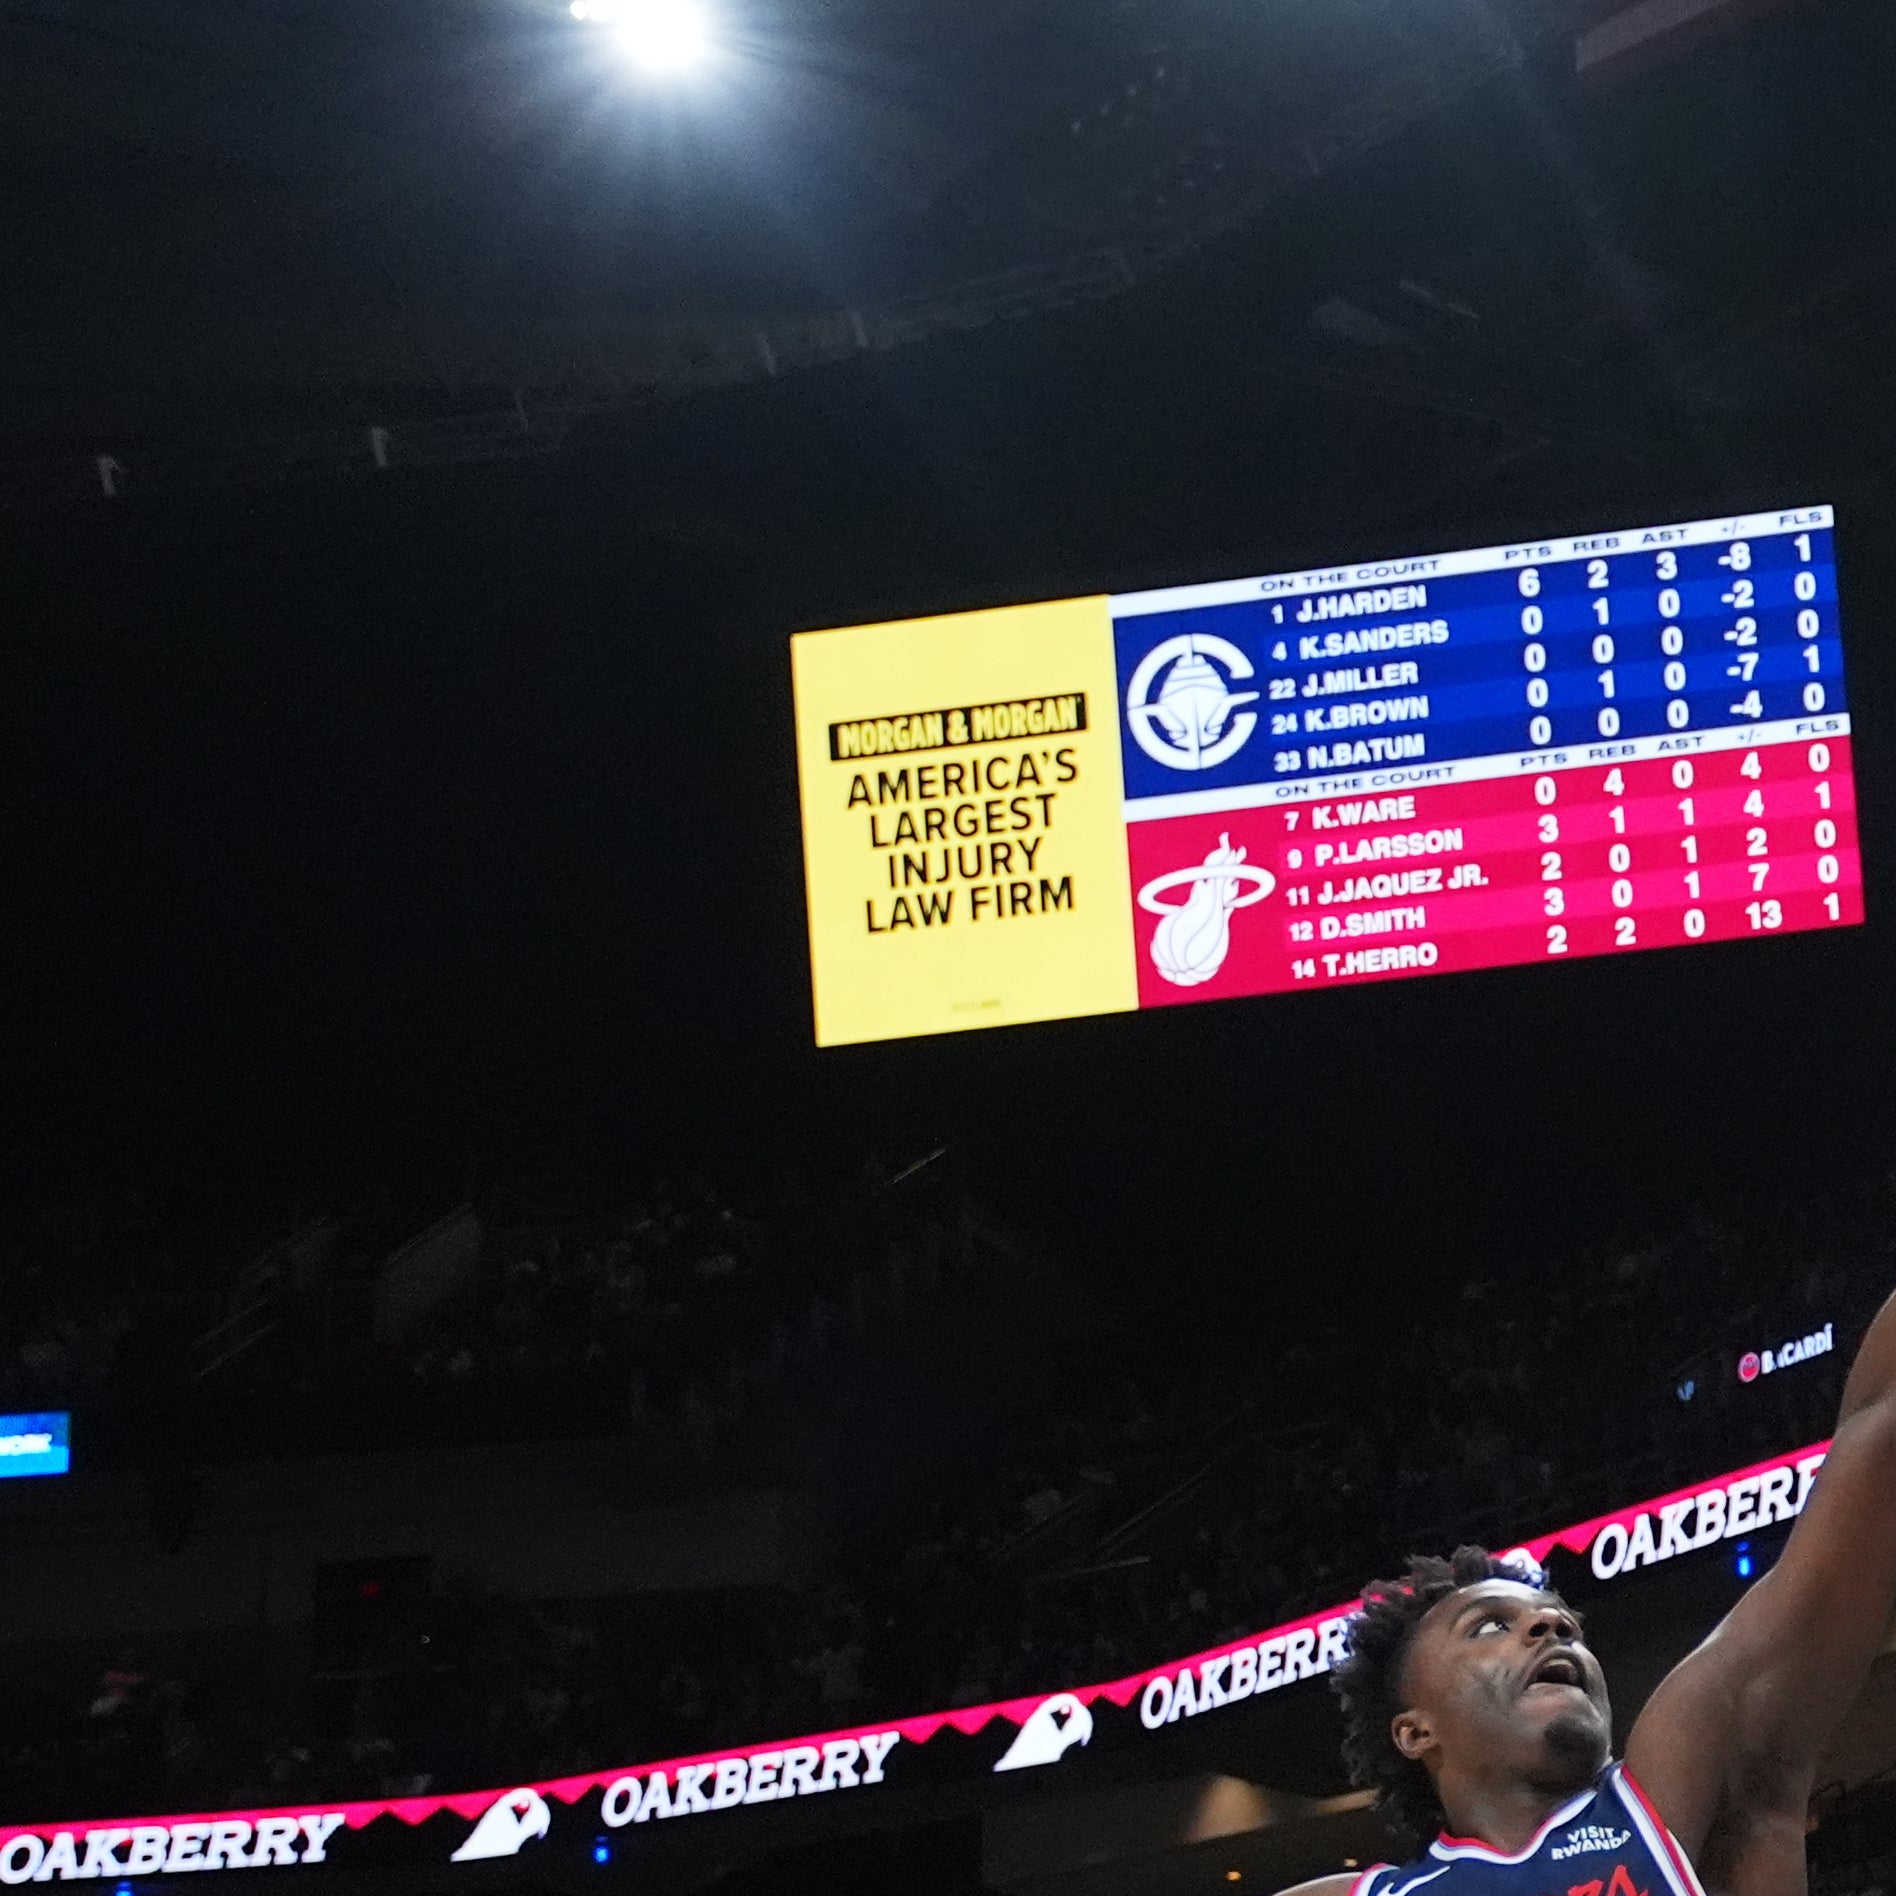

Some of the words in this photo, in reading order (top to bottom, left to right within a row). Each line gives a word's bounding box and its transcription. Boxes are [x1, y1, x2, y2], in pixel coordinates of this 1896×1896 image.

[1261, 578, 1294, 592] ON
[1303, 572, 1348, 587] THE
[1356, 559, 1441, 581] COURT
[1504, 546, 1552, 561] PTS
[1573, 538, 1620, 552] REB
[1641, 528, 1690, 545] AST
[1779, 511, 1823, 527] FLS
[1271, 603, 1284, 625] 1
[1296, 585, 1427, 623] J.HARDEN
[1518, 568, 1541, 598] 6
[1586, 559, 1610, 589] 2
[1656, 551, 1679, 580] 3
[1717, 541, 1752, 571] -8
[1793, 533, 1811, 562] 1
[1269, 678, 1297, 700] 22
[1302, 661, 1419, 698] J.MILLER
[1524, 643, 1546, 672] 0
[1592, 634, 1615, 664] 0
[1661, 626, 1684, 656] 0
[1723, 617, 1758, 646] -2
[1797, 609, 1820, 639] 0
[1272, 641, 1288, 662] 4
[1299, 619, 1449, 660] K.SANDERS
[1521, 605, 1543, 635] 0
[1592, 597, 1610, 625] 1
[1658, 588, 1681, 618] 0
[1720, 579, 1755, 609] -2
[1794, 571, 1817, 601] 0
[836, 711, 944, 759] MORGAN
[947, 708, 970, 745] &
[971, 695, 1079, 736] MORGAN
[1271, 713, 1299, 736] 24
[1304, 695, 1430, 733] K.BROWN
[1526, 677, 1549, 708] 0
[1598, 669, 1615, 698] 1
[1664, 661, 1687, 691] 0
[1726, 652, 1760, 681] -7
[1803, 644, 1821, 673] 1
[1273, 749, 1302, 773] 33
[1306, 733, 1426, 770] N.BATUM
[1529, 715, 1552, 745] 0
[1598, 707, 1620, 737] 0
[1667, 699, 1690, 729] 0
[1729, 690, 1764, 719] -4
[1803, 682, 1826, 712] 0
[848, 748, 1079, 810] AMERICA'S
[1275, 785, 1309, 798] ON
[1318, 778, 1363, 793] THE
[1371, 766, 1457, 787] COURT
[1520, 753, 1568, 768] PTS
[1588, 744, 1636, 760] REB
[1658, 736, 1706, 752] AST
[1795, 719, 1839, 735] FLS
[1284, 811, 1300, 831] 7
[1311, 795, 1416, 830] K.WARE
[1533, 776, 1556, 806] 0
[1603, 767, 1625, 796] 4
[1671, 760, 1694, 789] 0
[1740, 751, 1762, 779] 4
[1807, 743, 1830, 773] 0
[870, 793, 1056, 849] LARGEST
[888, 837, 1042, 889] INJURY
[1286, 885, 1310, 907] 11
[1317, 868, 1443, 905] J.JAQUEZ
[1447, 863, 1489, 890] JR.
[1540, 851, 1563, 881] 2
[1608, 843, 1631, 873] 0
[1681, 835, 1698, 863] 1
[1746, 827, 1769, 857] 2
[1814, 819, 1837, 849] 0
[1287, 848, 1303, 869] 9
[1314, 828, 1463, 867] P.LARSSON
[1537, 813, 1560, 843] 3
[1608, 805, 1626, 834] 1
[1677, 797, 1695, 826] 1
[1743, 789, 1765, 817] 4
[1814, 781, 1831, 809] 1
[866, 891, 953, 934] LAW
[971, 876, 1075, 921] FIRM
[1288, 920, 1314, 942] 12
[1320, 906, 1426, 940] D.SMITH
[1543, 887, 1565, 916] 3
[1611, 878, 1633, 908] 0
[1683, 870, 1701, 899] 1
[1748, 862, 1770, 892] 7
[1817, 854, 1840, 884] 0
[1291, 958, 1317, 979] 14
[1321, 942, 1439, 977] T.HERRO
[1546, 924, 1569, 954] 2
[1614, 916, 1637, 946] 2
[1683, 909, 1706, 938] 0
[1744, 899, 1784, 930] 13
[1823, 892, 1841, 921] 1
[1140, 1612, 1356, 1730] OAKBERR
[601, 1731, 900, 1828] OAKBERRY
[0, 1813, 346, 1884] OAKBERRY
[1550, 1829, 1632, 1861] RWANDA
[1566, 1825, 1615, 1843] VISIT
